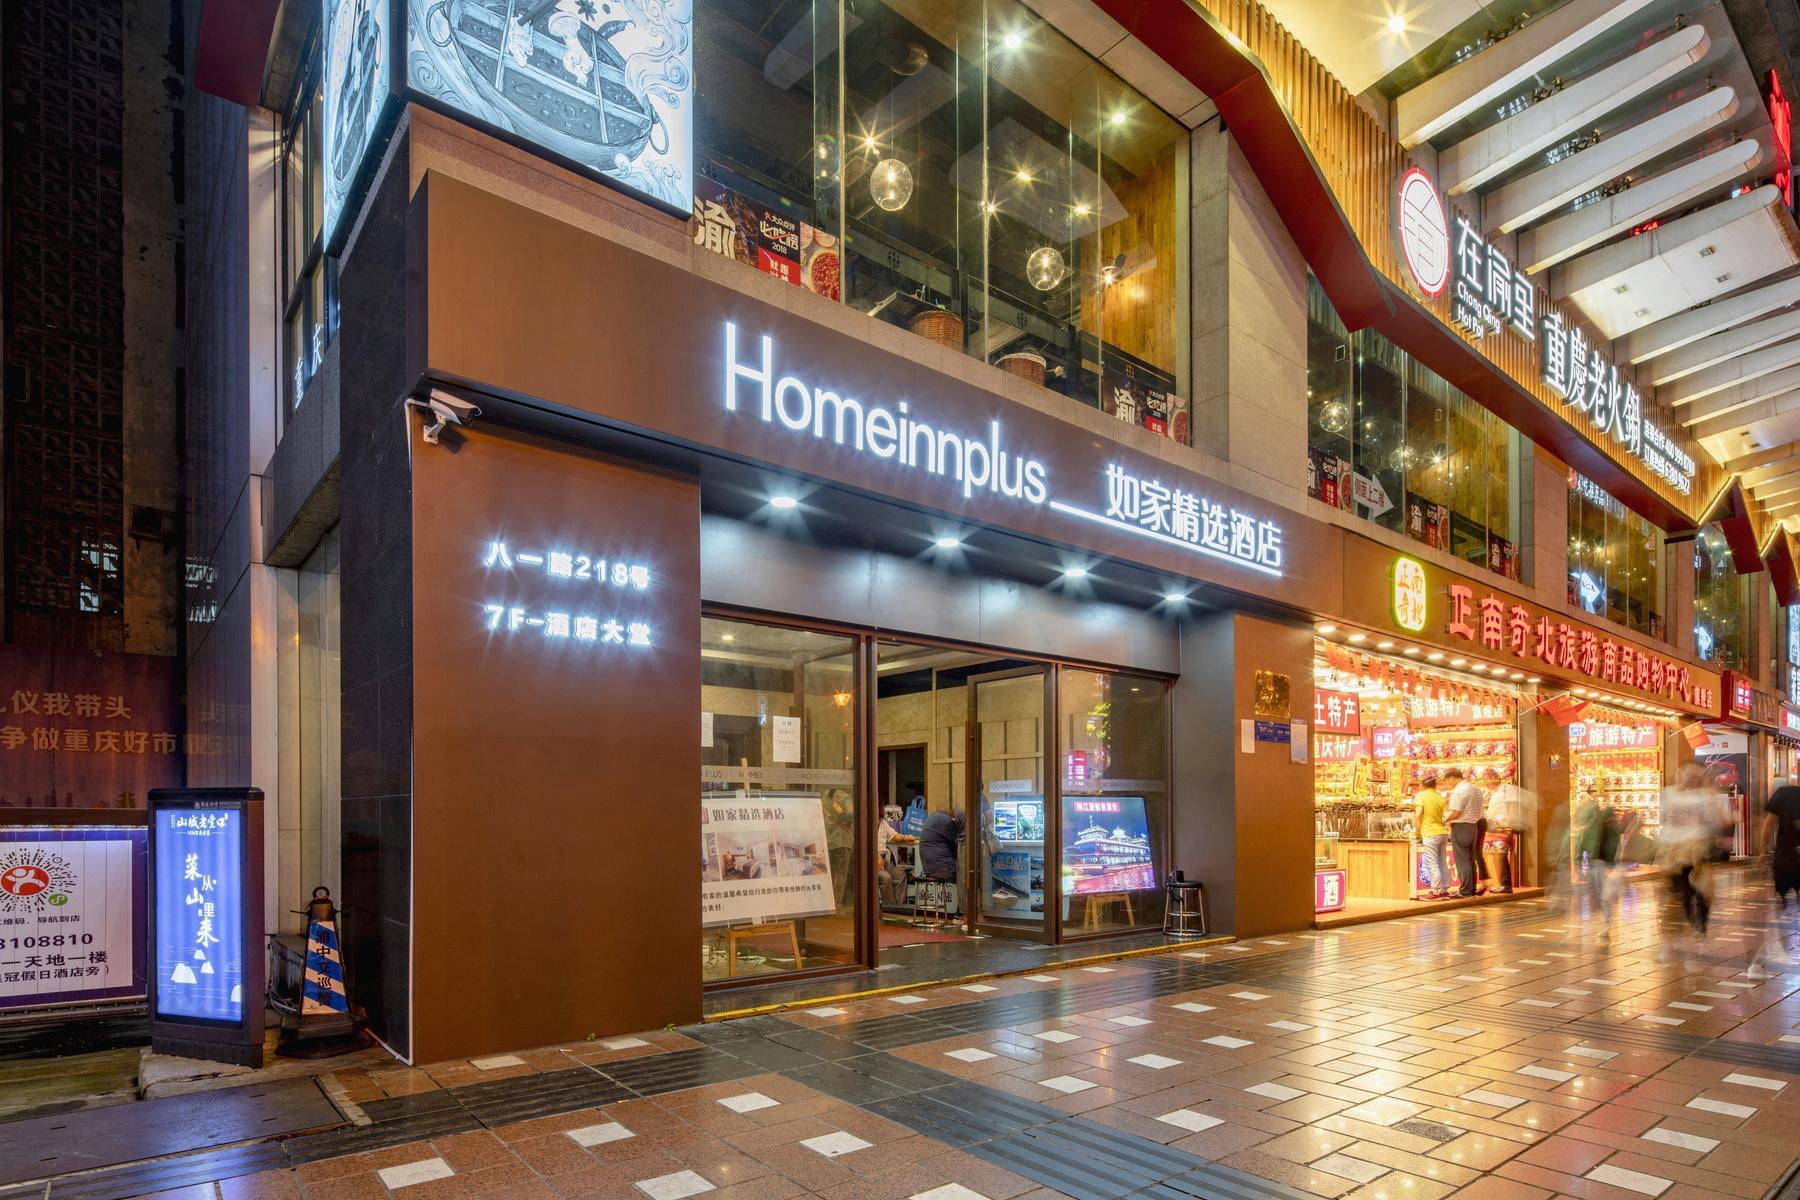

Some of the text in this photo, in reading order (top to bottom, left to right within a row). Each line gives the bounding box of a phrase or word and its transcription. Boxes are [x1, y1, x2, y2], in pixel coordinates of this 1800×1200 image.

[1458, 281, 1500, 335] Chong Qing
[1458, 304, 1484, 339] Hot Pot
[725, 321, 1048, 505] Homeinnplus
[1106, 463, 1284, 570] 如家精选酒店
[1449, 584, 1691, 702] 正南奇北旅游商品购物中心
[1323, 874, 1339, 906] 酒
[0, 965, 109, 983] 冠假日酒店旁）
